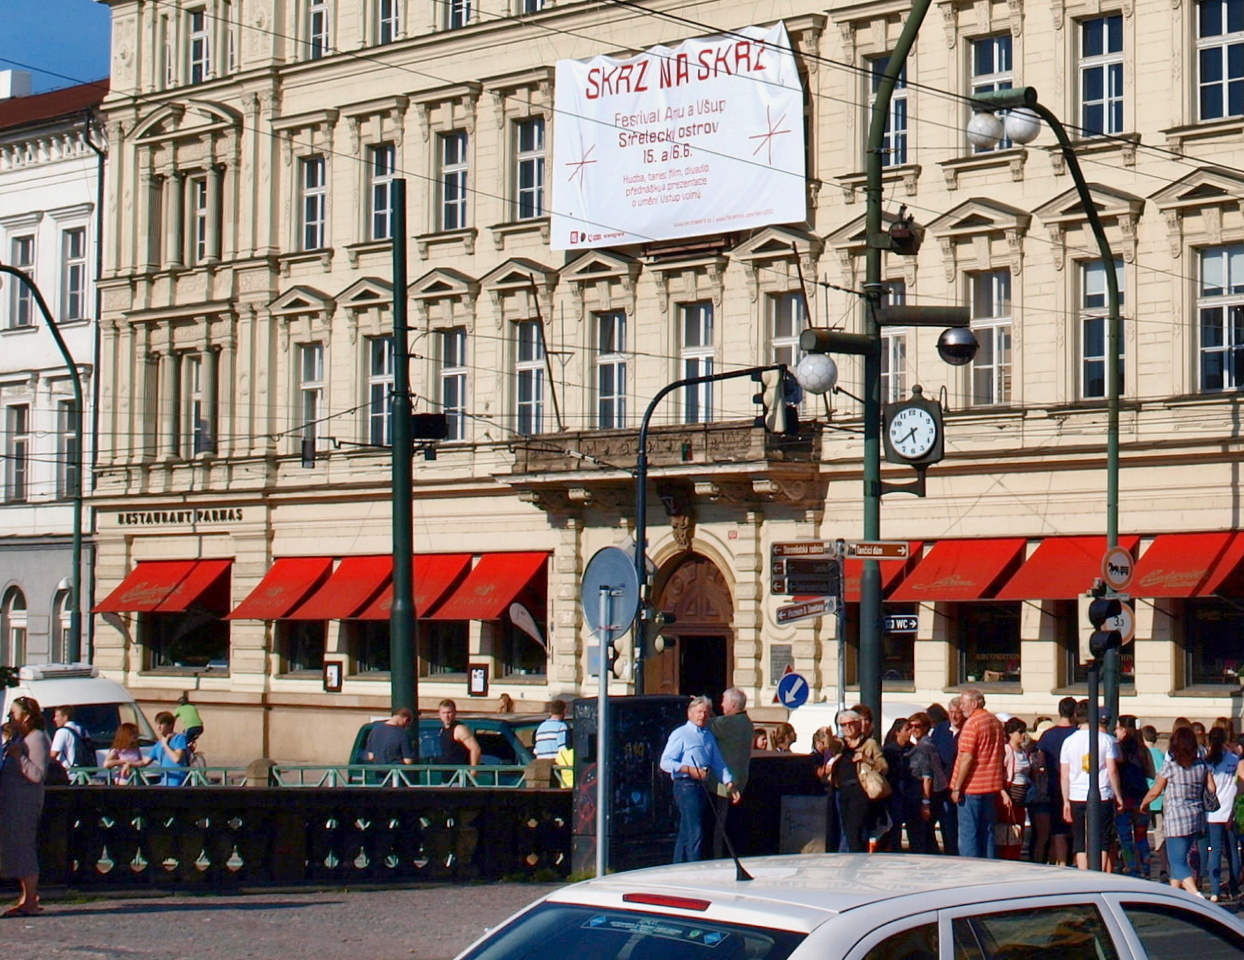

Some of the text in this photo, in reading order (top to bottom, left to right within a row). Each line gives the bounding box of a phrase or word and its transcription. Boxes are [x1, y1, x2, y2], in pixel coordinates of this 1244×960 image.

[586, 39, 767, 99] SKRZ NA SKRZ
[614, 109, 660, 128] Festival
[687, 105, 694, 117] a
[618, 121, 719, 148] Střelecký ostrov
[117, 508, 243, 525] RESTAURANT PARNAS
[896, 619, 908, 629] WC
